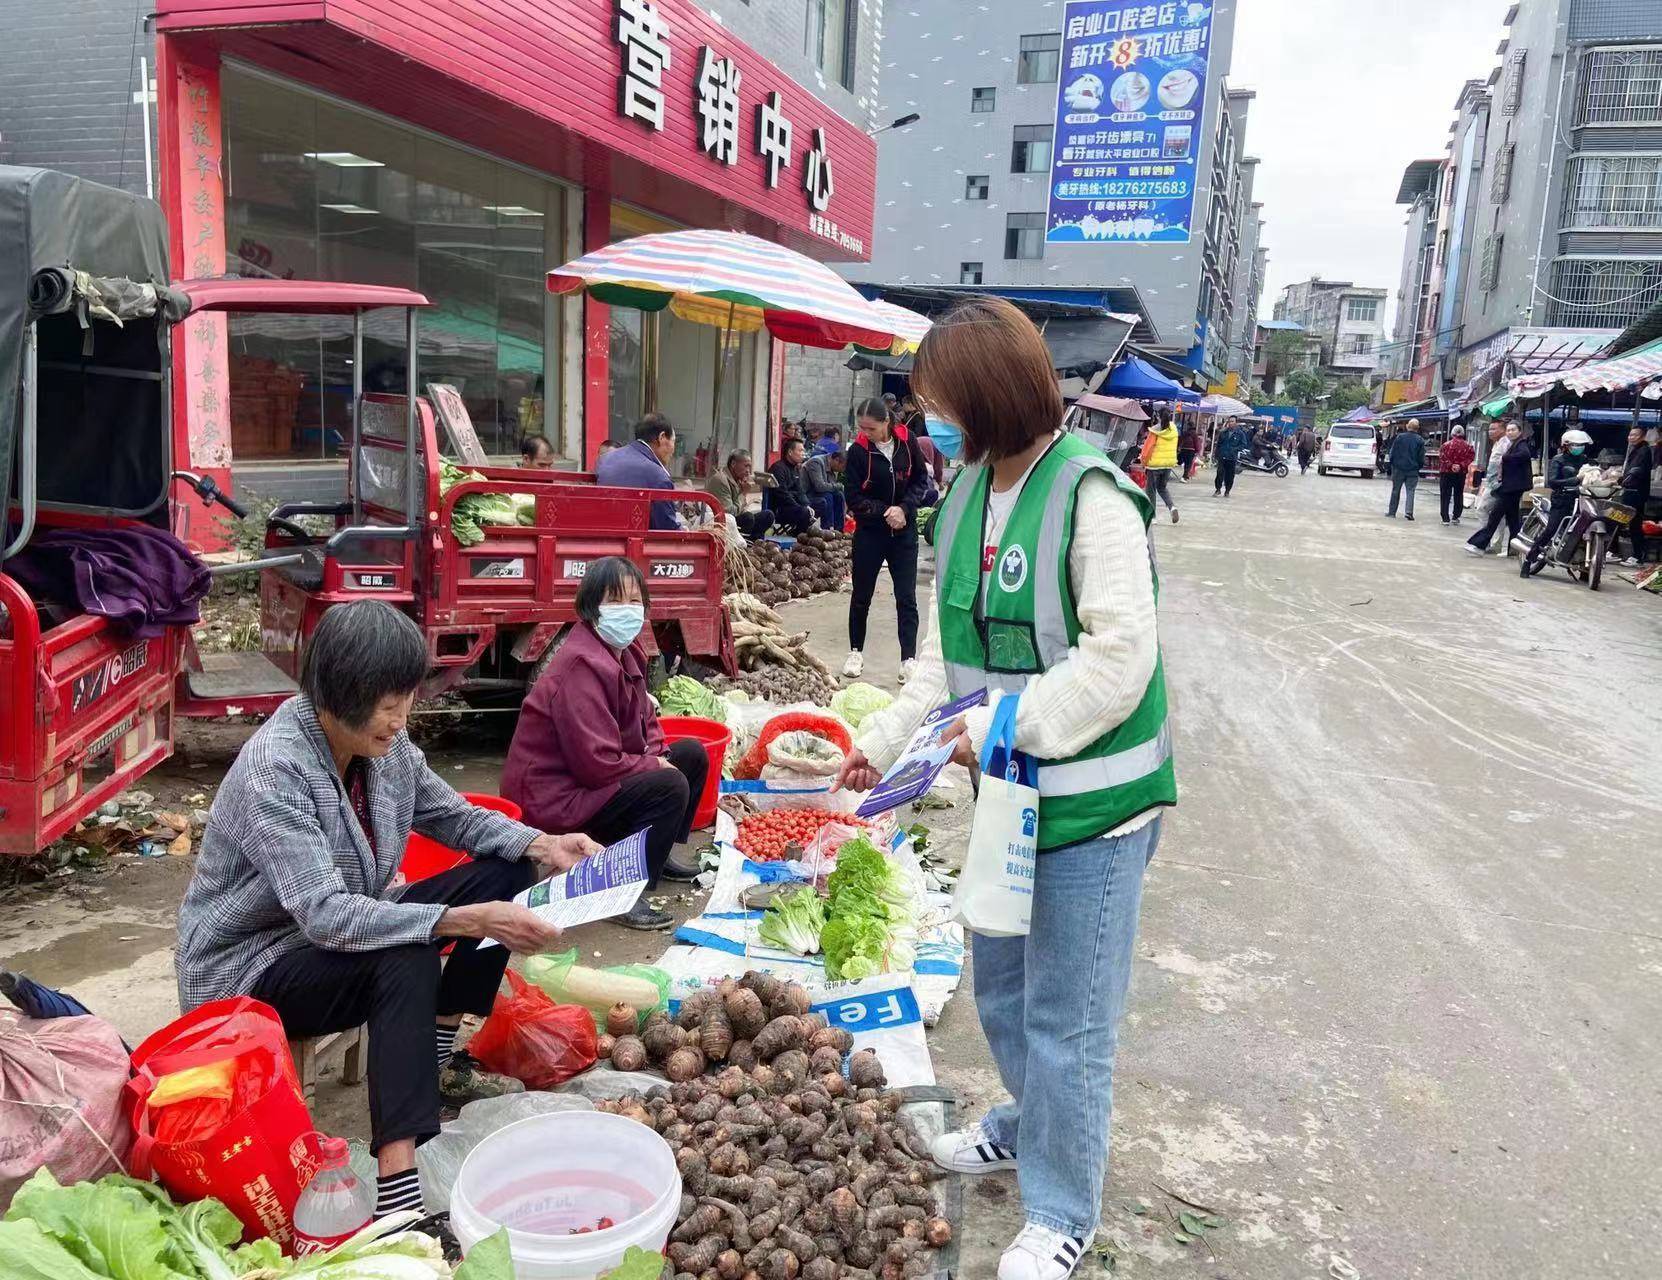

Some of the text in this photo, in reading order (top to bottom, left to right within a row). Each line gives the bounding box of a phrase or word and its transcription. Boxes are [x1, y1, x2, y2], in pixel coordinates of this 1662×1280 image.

[1067, 4, 1176, 39] 启业口腔老店
[617, 0, 835, 212] 营销中心
